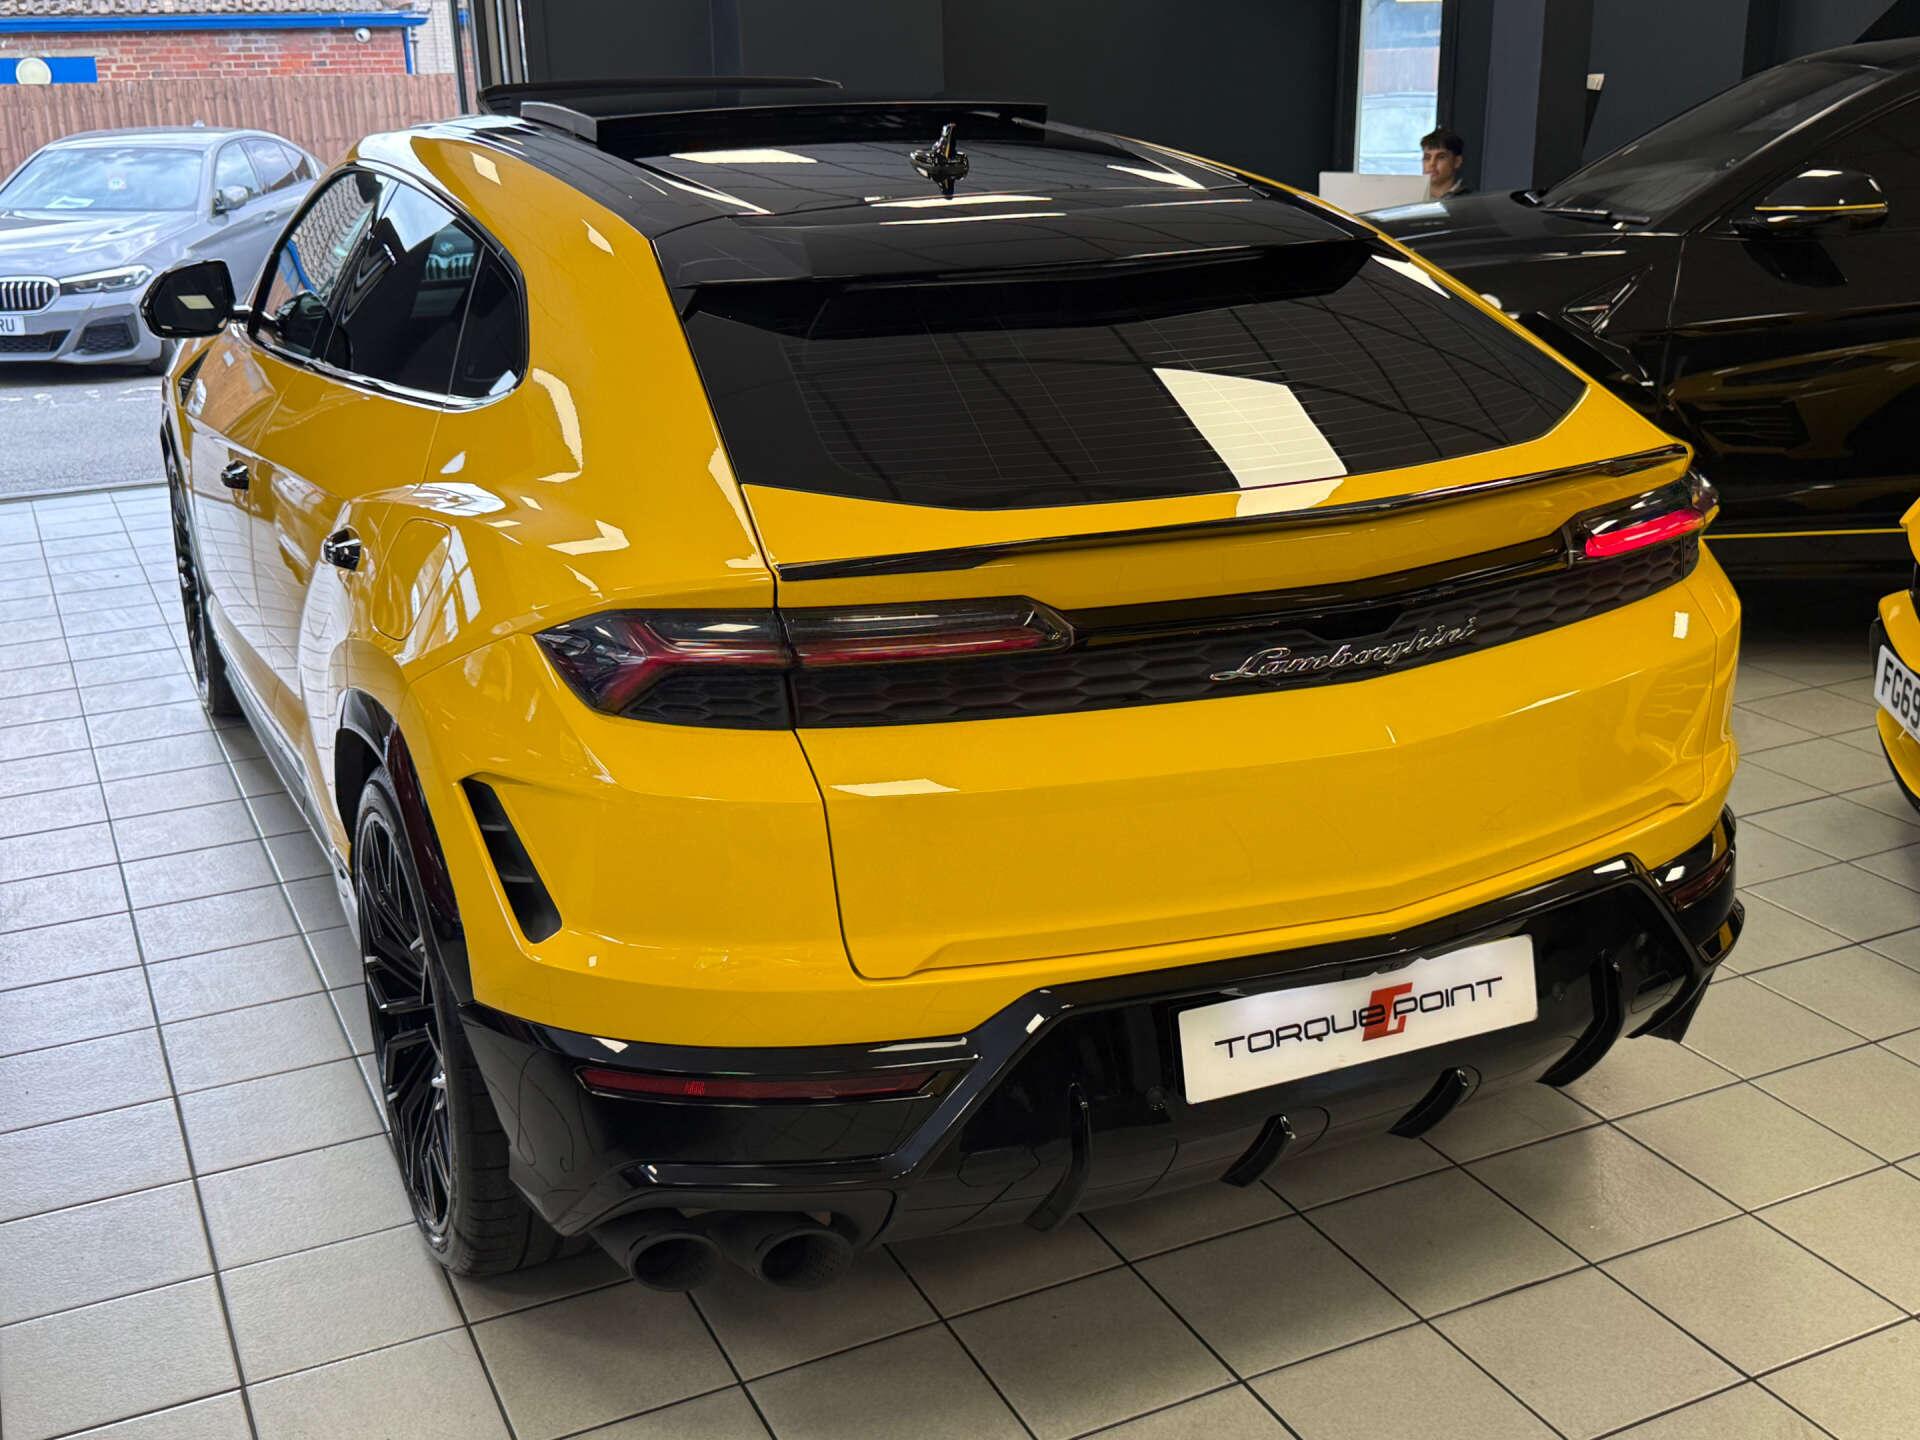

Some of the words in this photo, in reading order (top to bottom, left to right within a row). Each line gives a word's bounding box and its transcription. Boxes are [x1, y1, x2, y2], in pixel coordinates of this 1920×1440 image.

[1210, 617, 1477, 681] Lamborghini
[1881, 658, 1920, 729] FG69
[1214, 1003, 1386, 1059] TORQUE
[1393, 976, 1503, 1020] POINT
